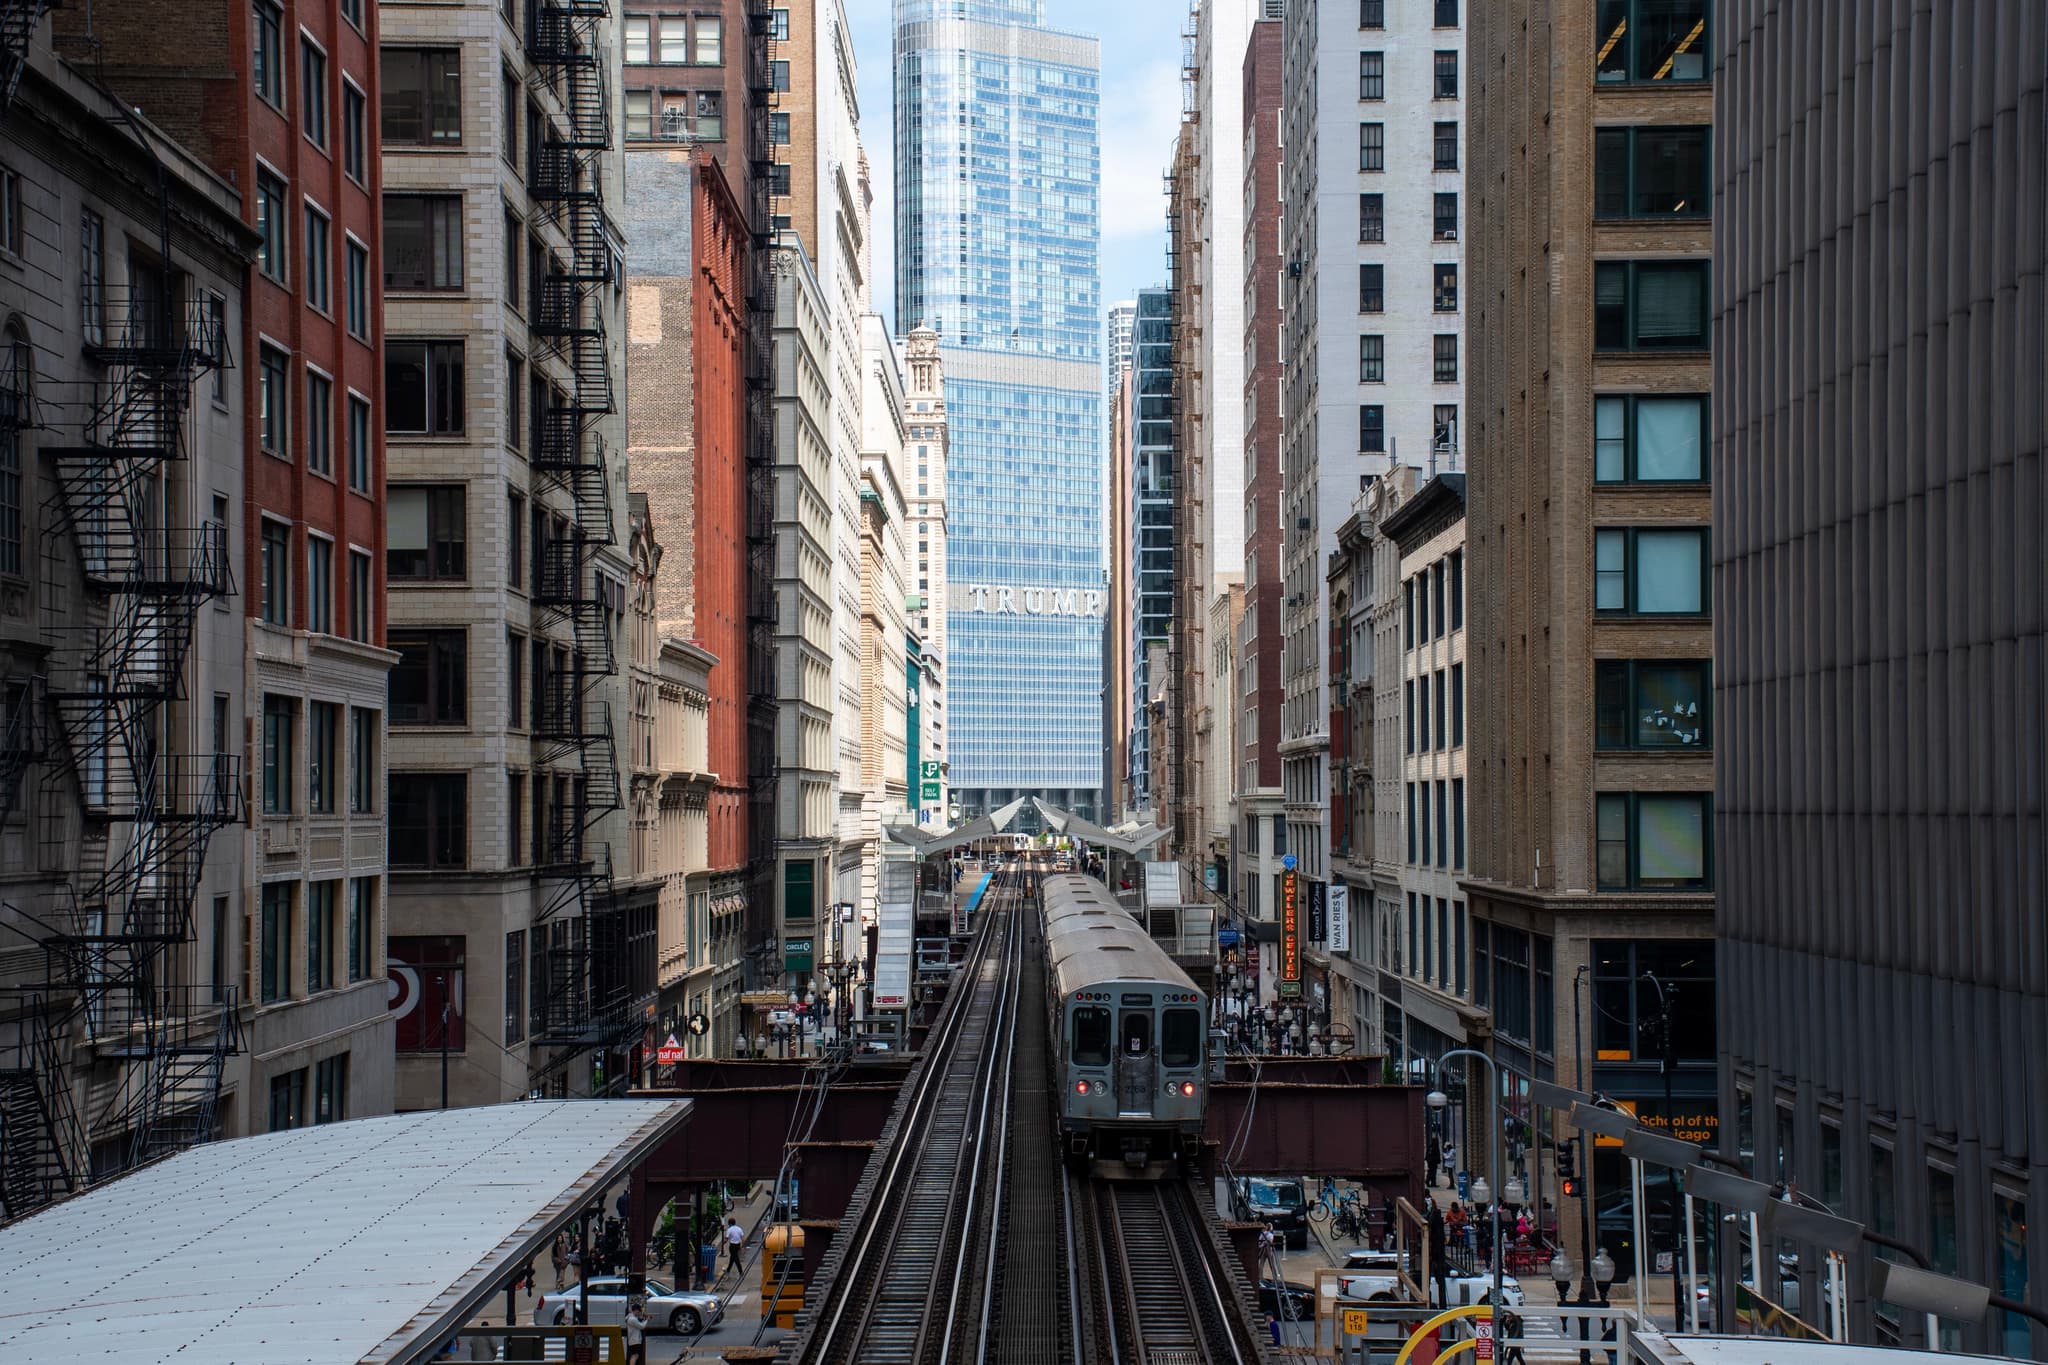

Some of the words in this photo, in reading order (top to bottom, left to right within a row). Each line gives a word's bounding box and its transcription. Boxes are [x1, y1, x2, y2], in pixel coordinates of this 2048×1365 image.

[969, 584, 1100, 617] TRUMP
[1284, 873, 1296, 932] JEWELERS
[1332, 900, 1341, 923] RIES
[1333, 924, 1341, 948] IWAN
[1286, 934, 1295, 978] CENTER
[658, 1050, 670, 1059] naf
[671, 1050, 683, 1059] naf
[1687, 1115, 1701, 1126] of
